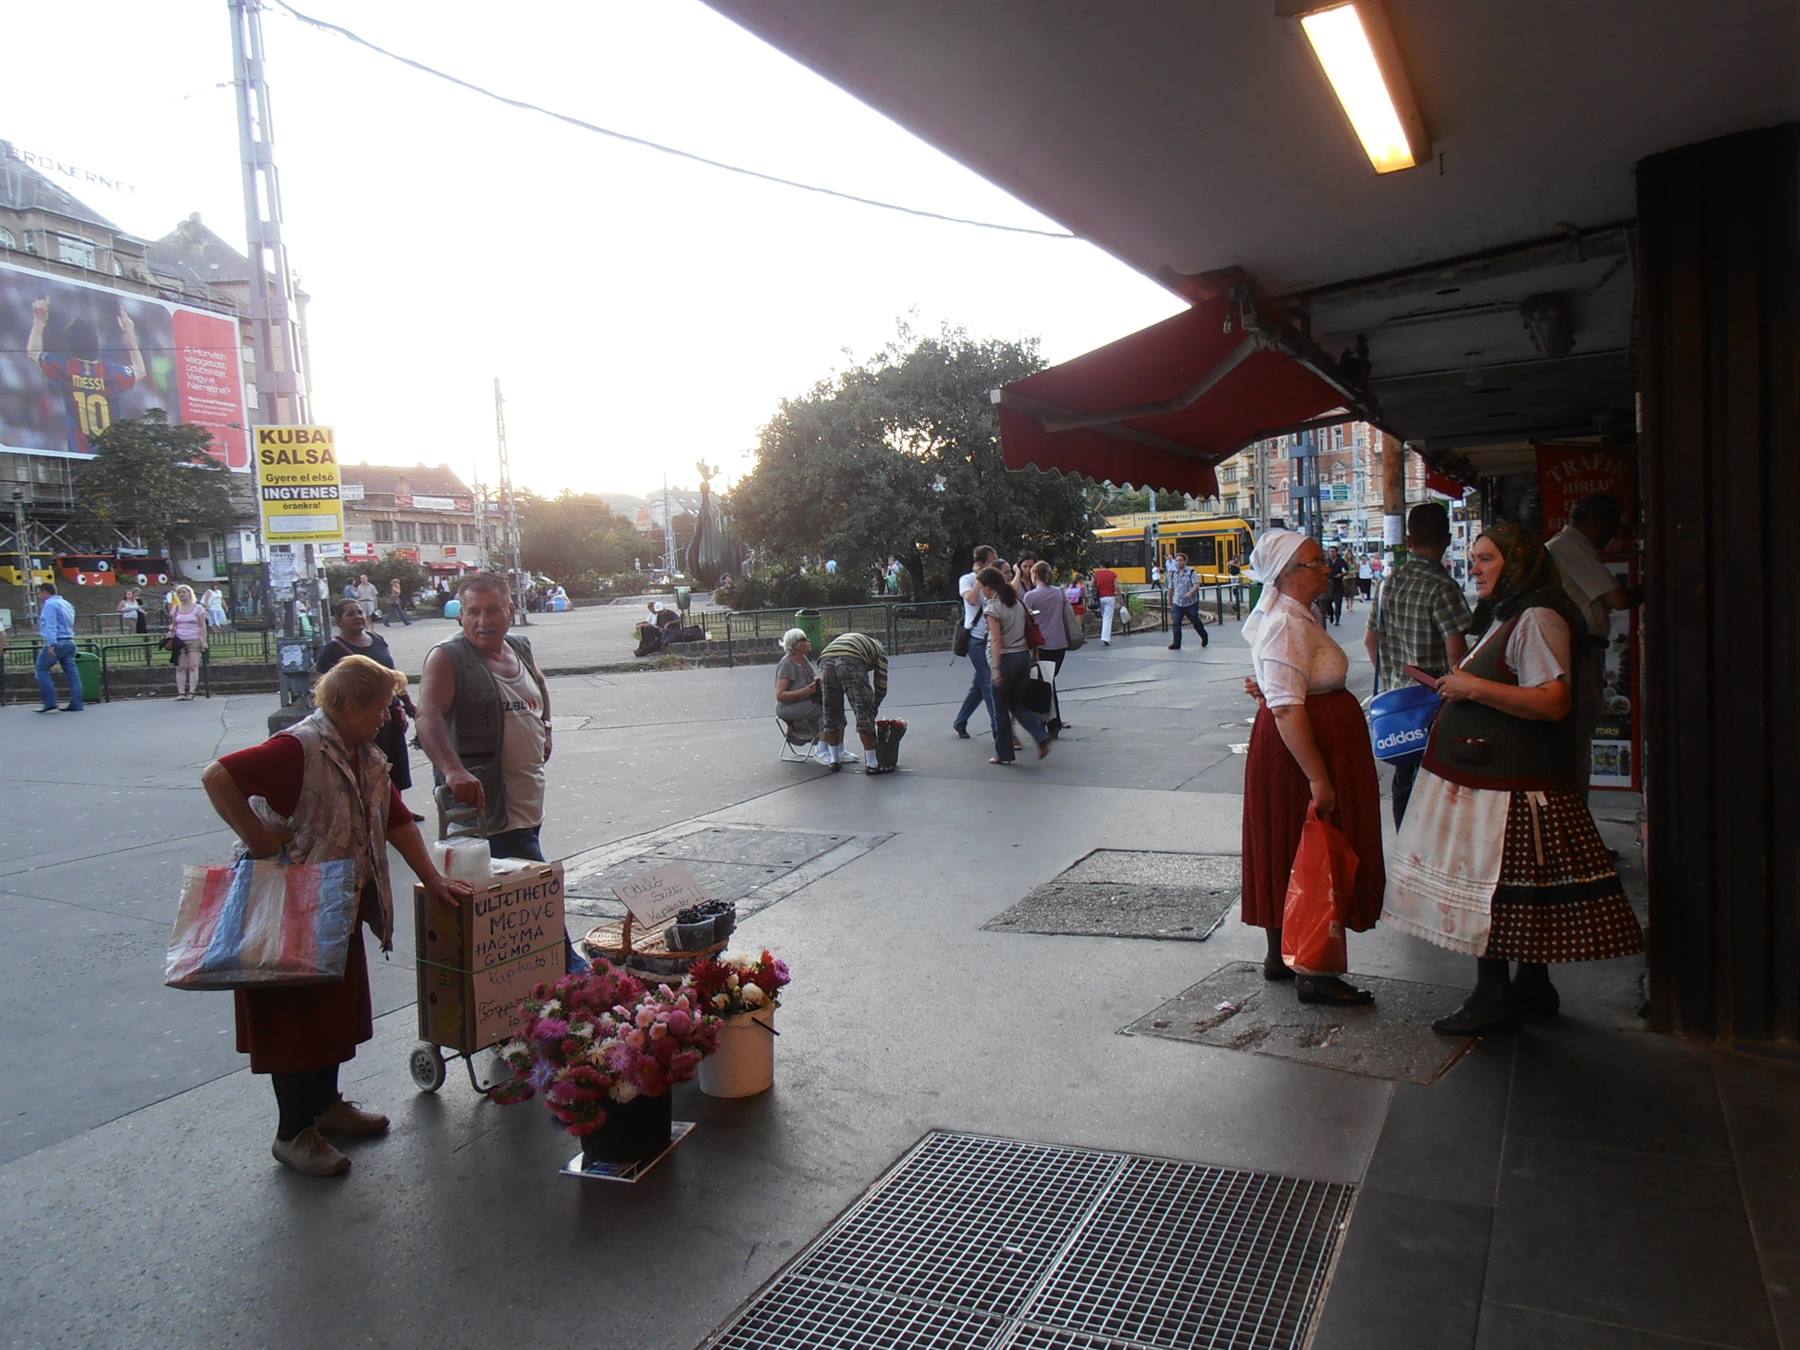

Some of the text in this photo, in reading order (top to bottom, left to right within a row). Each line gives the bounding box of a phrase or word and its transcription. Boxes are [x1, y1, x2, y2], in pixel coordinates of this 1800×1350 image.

[72, 374, 105, 390] MESSI
[73, 391, 111, 436] 10
[260, 430, 335, 444] KUBAI
[261, 449, 335, 465] SALSA
[266, 473, 298, 484] Gyere
[300, 473, 310, 481] el
[264, 486, 338, 499] INGYENES
[1377, 729, 1424, 750] adidas
[489, 902, 554, 935] MEDVE
[476, 925, 544, 956] HAGYMA
